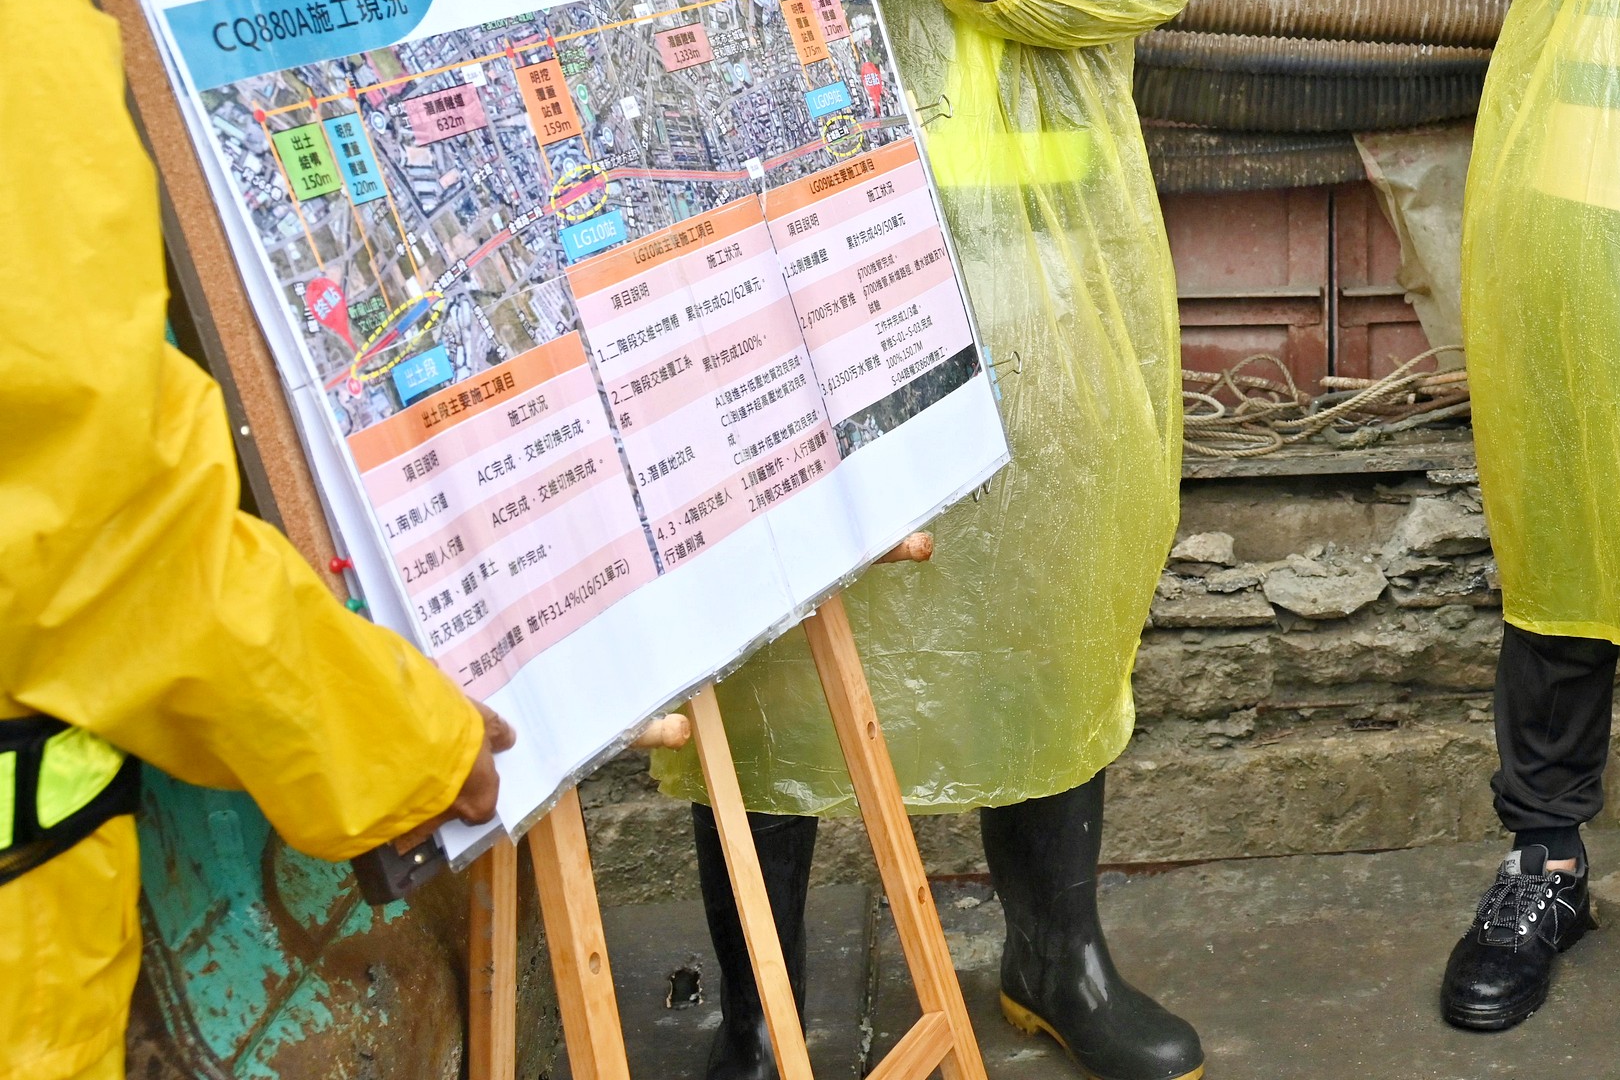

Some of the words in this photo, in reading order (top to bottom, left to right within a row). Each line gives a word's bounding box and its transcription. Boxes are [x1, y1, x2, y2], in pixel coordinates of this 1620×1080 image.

[824, 23, 843, 37] 170m
[673, 47, 701, 65] 1,333m
[803, 45, 823, 58] 175m
[529, 68, 551, 85] 明挖
[422, 92, 466, 116] 潛盾隧道
[534, 85, 557, 102] 覆蓋
[812, 90, 843, 110] LG09站
[436, 114, 466, 132] 632m
[541, 102, 563, 119] 站體
[543, 119, 572, 137] 159m
[290, 133, 315, 151] 出土
[298, 151, 322, 170] 結構
[301, 173, 332, 191] 150m
[353, 180, 378, 197] 220m
[809, 158, 875, 195] LG09站主要施工項目
[865, 180, 895, 203] 施工狀況
[572, 224, 617, 249] LG10站
[786, 212, 820, 237] 項目說明
[845, 212, 906, 250] 累計完成49/50單元
[632, 220, 715, 265] LG10站主要施工項目
[706, 242, 743, 270] 施工狀況
[784, 248, 829, 279] 1.北側連續壁
[312, 286, 342, 320] 終點
[610, 281, 651, 311] 項目說明
[403, 356, 439, 388] 出土段
[610, 354, 694, 406] 2.二階段交維覆工系
[420, 371, 516, 429] 出土段主要施工項目
[507, 394, 549, 427] 施工狀況
[620, 412, 633, 430] 統
[402, 450, 440, 483] 項目說明
[638, 445, 696, 487] 3.潛盾地改良
[385, 491, 449, 539] 1.南側人行道
[402, 534, 465, 583] 2.北側人行道
[664, 531, 706, 566] 行道削減
[526, 557, 631, 634] 施作31.4%(16/51單元)
